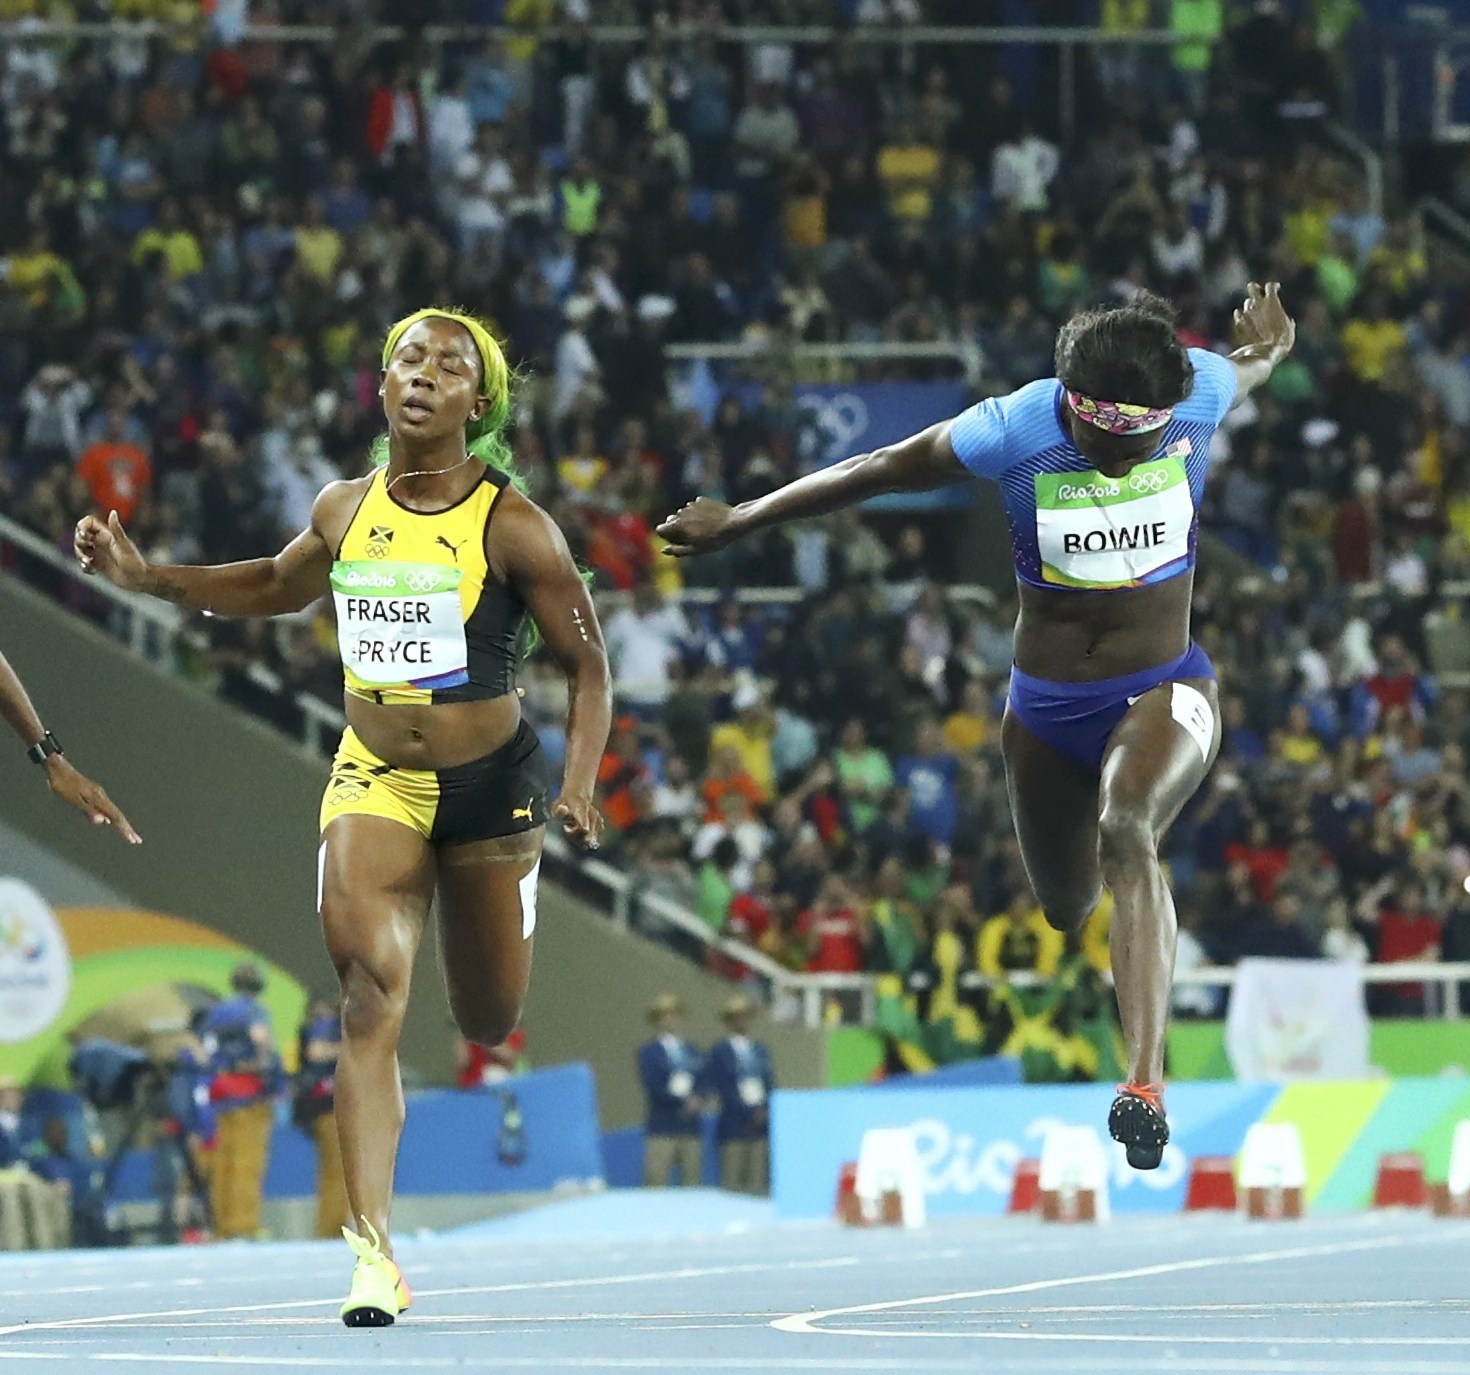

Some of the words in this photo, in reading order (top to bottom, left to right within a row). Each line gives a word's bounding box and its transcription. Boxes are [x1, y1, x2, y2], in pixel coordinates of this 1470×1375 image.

[1058, 481, 1121, 500] Rio2016
[1063, 522, 1167, 554] BOWIE
[347, 599, 432, 624] FRASER
